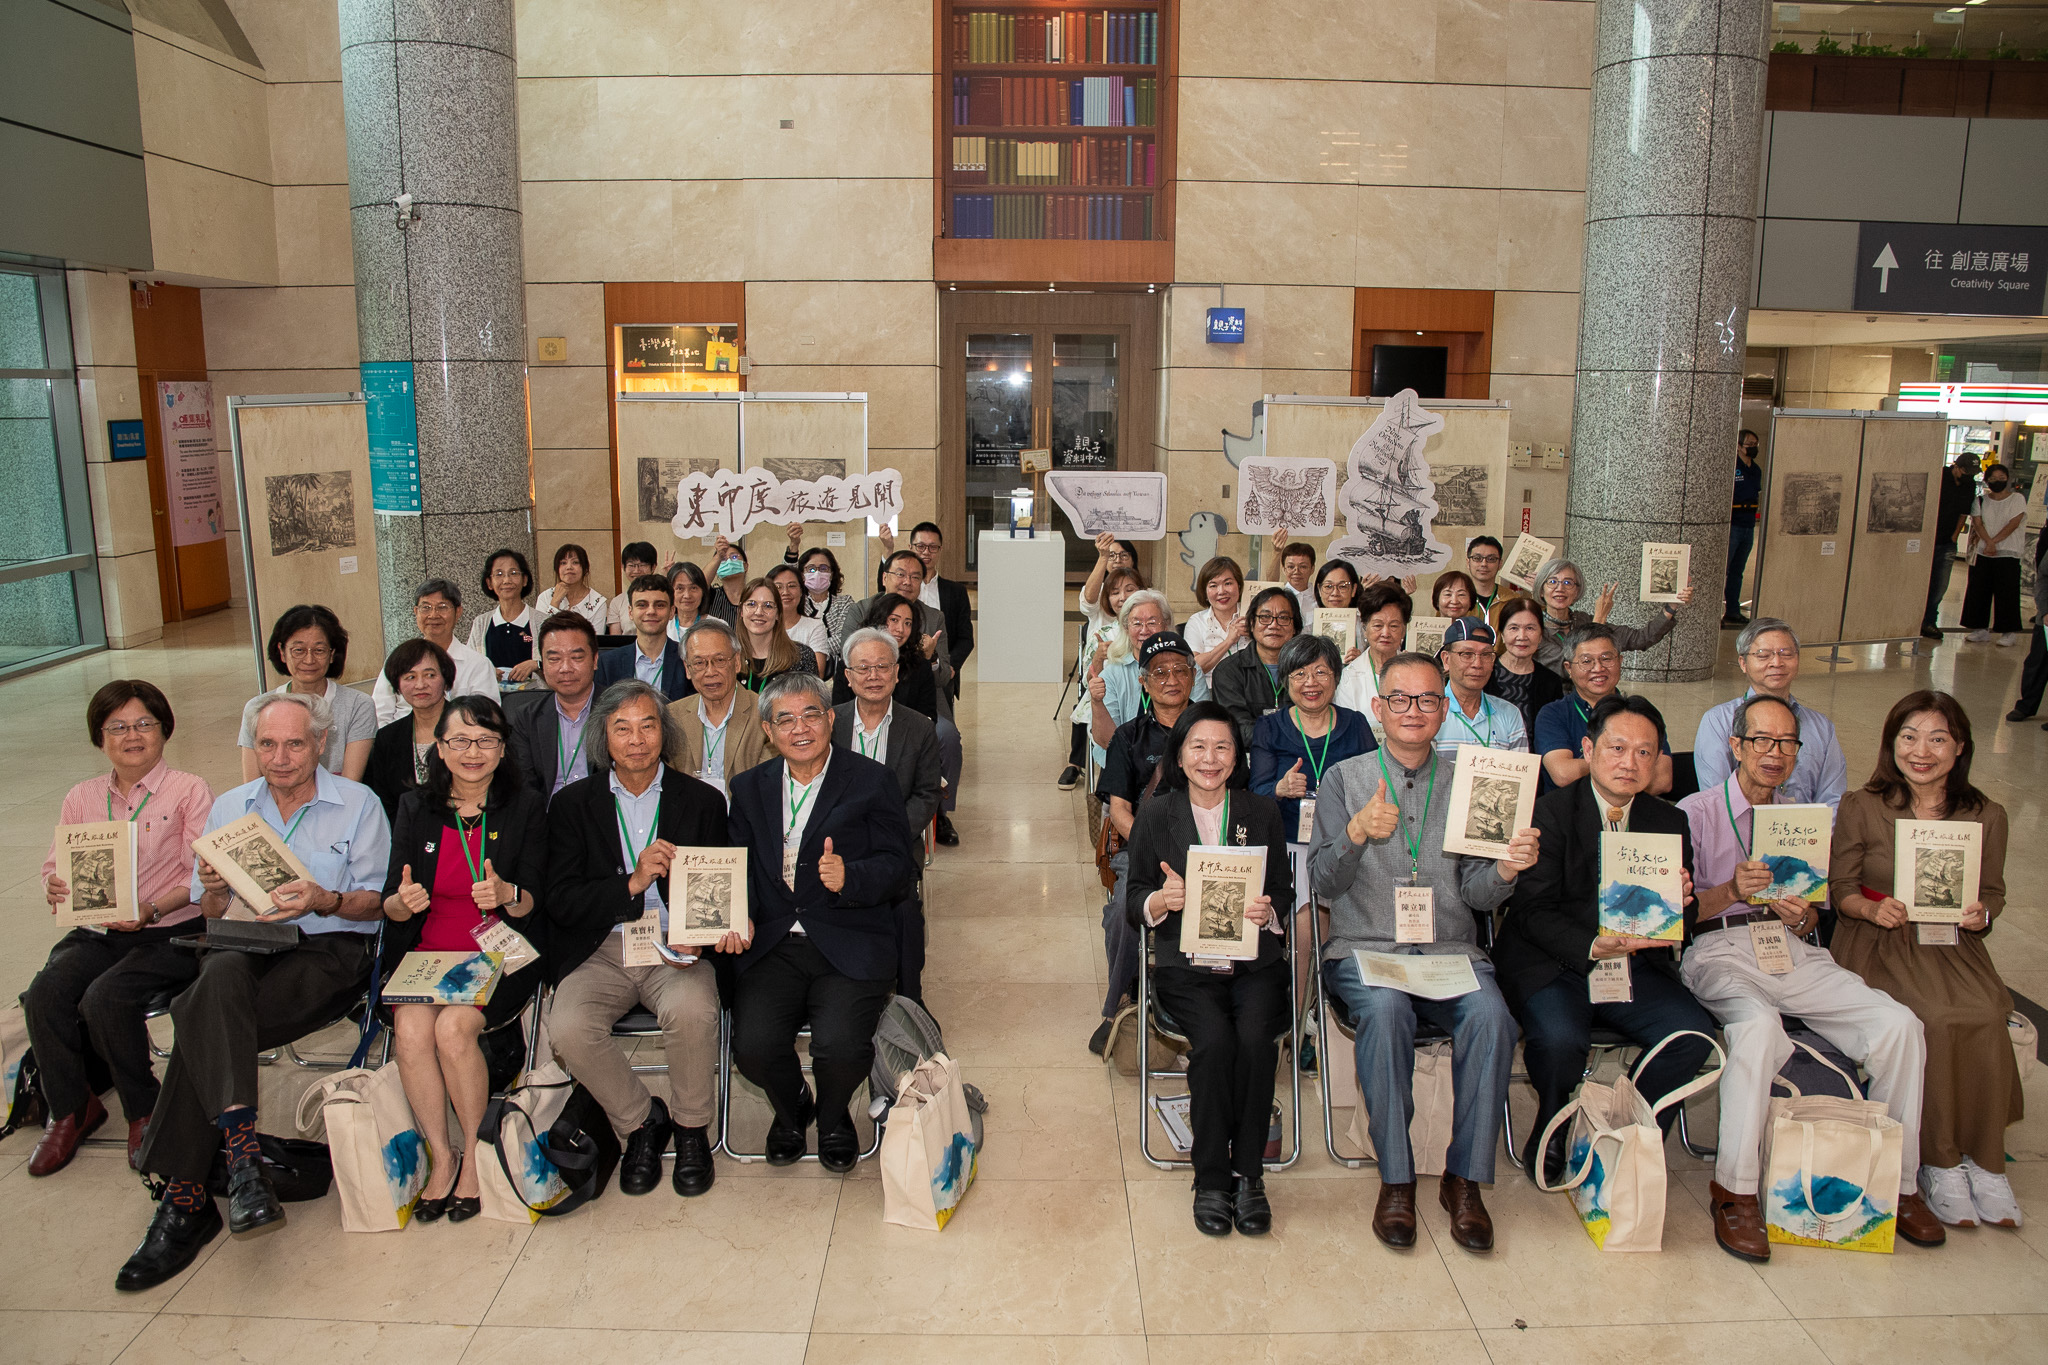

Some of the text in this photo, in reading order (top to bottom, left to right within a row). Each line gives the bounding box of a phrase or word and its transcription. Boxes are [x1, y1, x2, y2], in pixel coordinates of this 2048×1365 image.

[1924, 249, 2029, 272] 往 創意廣場
[1950, 278, 2030, 291] Creativity Square
[1074, 435, 1101, 453] 親子
[1063, 449, 1106, 464] 資料中心
[684, 478, 894, 532] 東印度旅遊見聞
